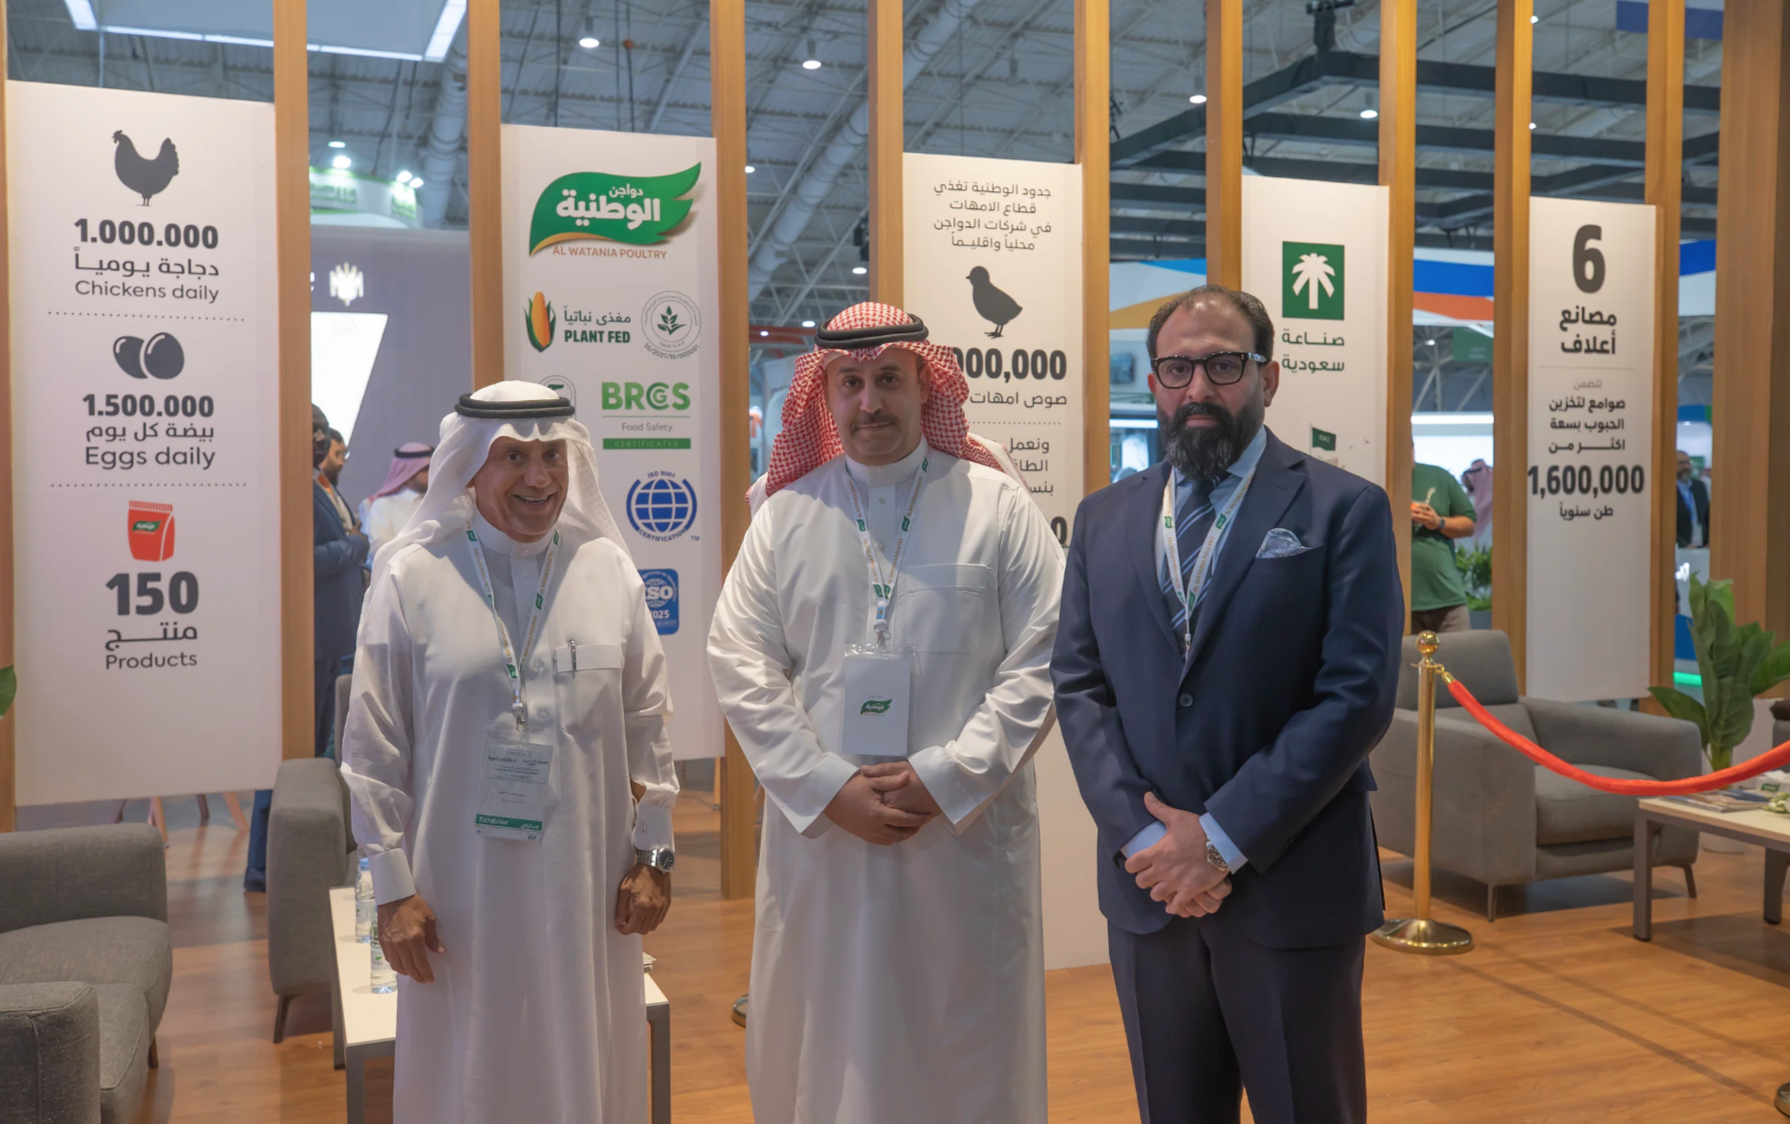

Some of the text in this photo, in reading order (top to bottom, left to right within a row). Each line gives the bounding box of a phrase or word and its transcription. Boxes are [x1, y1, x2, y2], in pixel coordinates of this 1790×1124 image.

[609, 184, 644, 198] دواجن
[933, 180, 1051, 199] جدود الوطنية تغذي
[556, 189, 661, 230] الوطنية
[949, 200, 1037, 216] قطاع الامهات
[74, 218, 218, 249] 1.000.000
[933, 217, 1052, 238] في شركات الدواجن
[553, 246, 667, 259] AL WATANIA POULTRY
[1572, 224, 1606, 294] 6
[158, 258, 219, 279] دجاجة
[75, 280, 219, 303] Chickens daily
[1559, 305, 1617, 332] مصانع
[564, 330, 631, 343] PLANT FED
[1282, 328, 1345, 346] صناعة
[1561, 329, 1616, 355] أعلاف
[1282, 354, 1345, 374] سعودية
[82, 394, 214, 417] 1.500.000
[969, 391, 1067, 409] صوص امهات
[1549, 396, 1626, 413] صوامع لتخزين
[86, 422, 214, 442] بيضة كل يوم
[621, 422, 673, 433] Food Safety
[1550, 417, 1625, 433] الحبوب بسعة
[614, 440, 679, 448] CERTIFICATED
[1549, 437, 1626, 454] اكثر من
[85, 446, 216, 470] Eggs daily
[647, 470, 675, 478] ISO 9001
[1527, 464, 1645, 500] 1,600,000
[1594, 505, 1614, 521] طن
[638, 527, 688, 542] CERTIFICATION
[105, 571, 199, 616] 150
[645, 586, 673, 600] SO
[105, 622, 197, 651] منتج
[106, 652, 197, 670] Products
